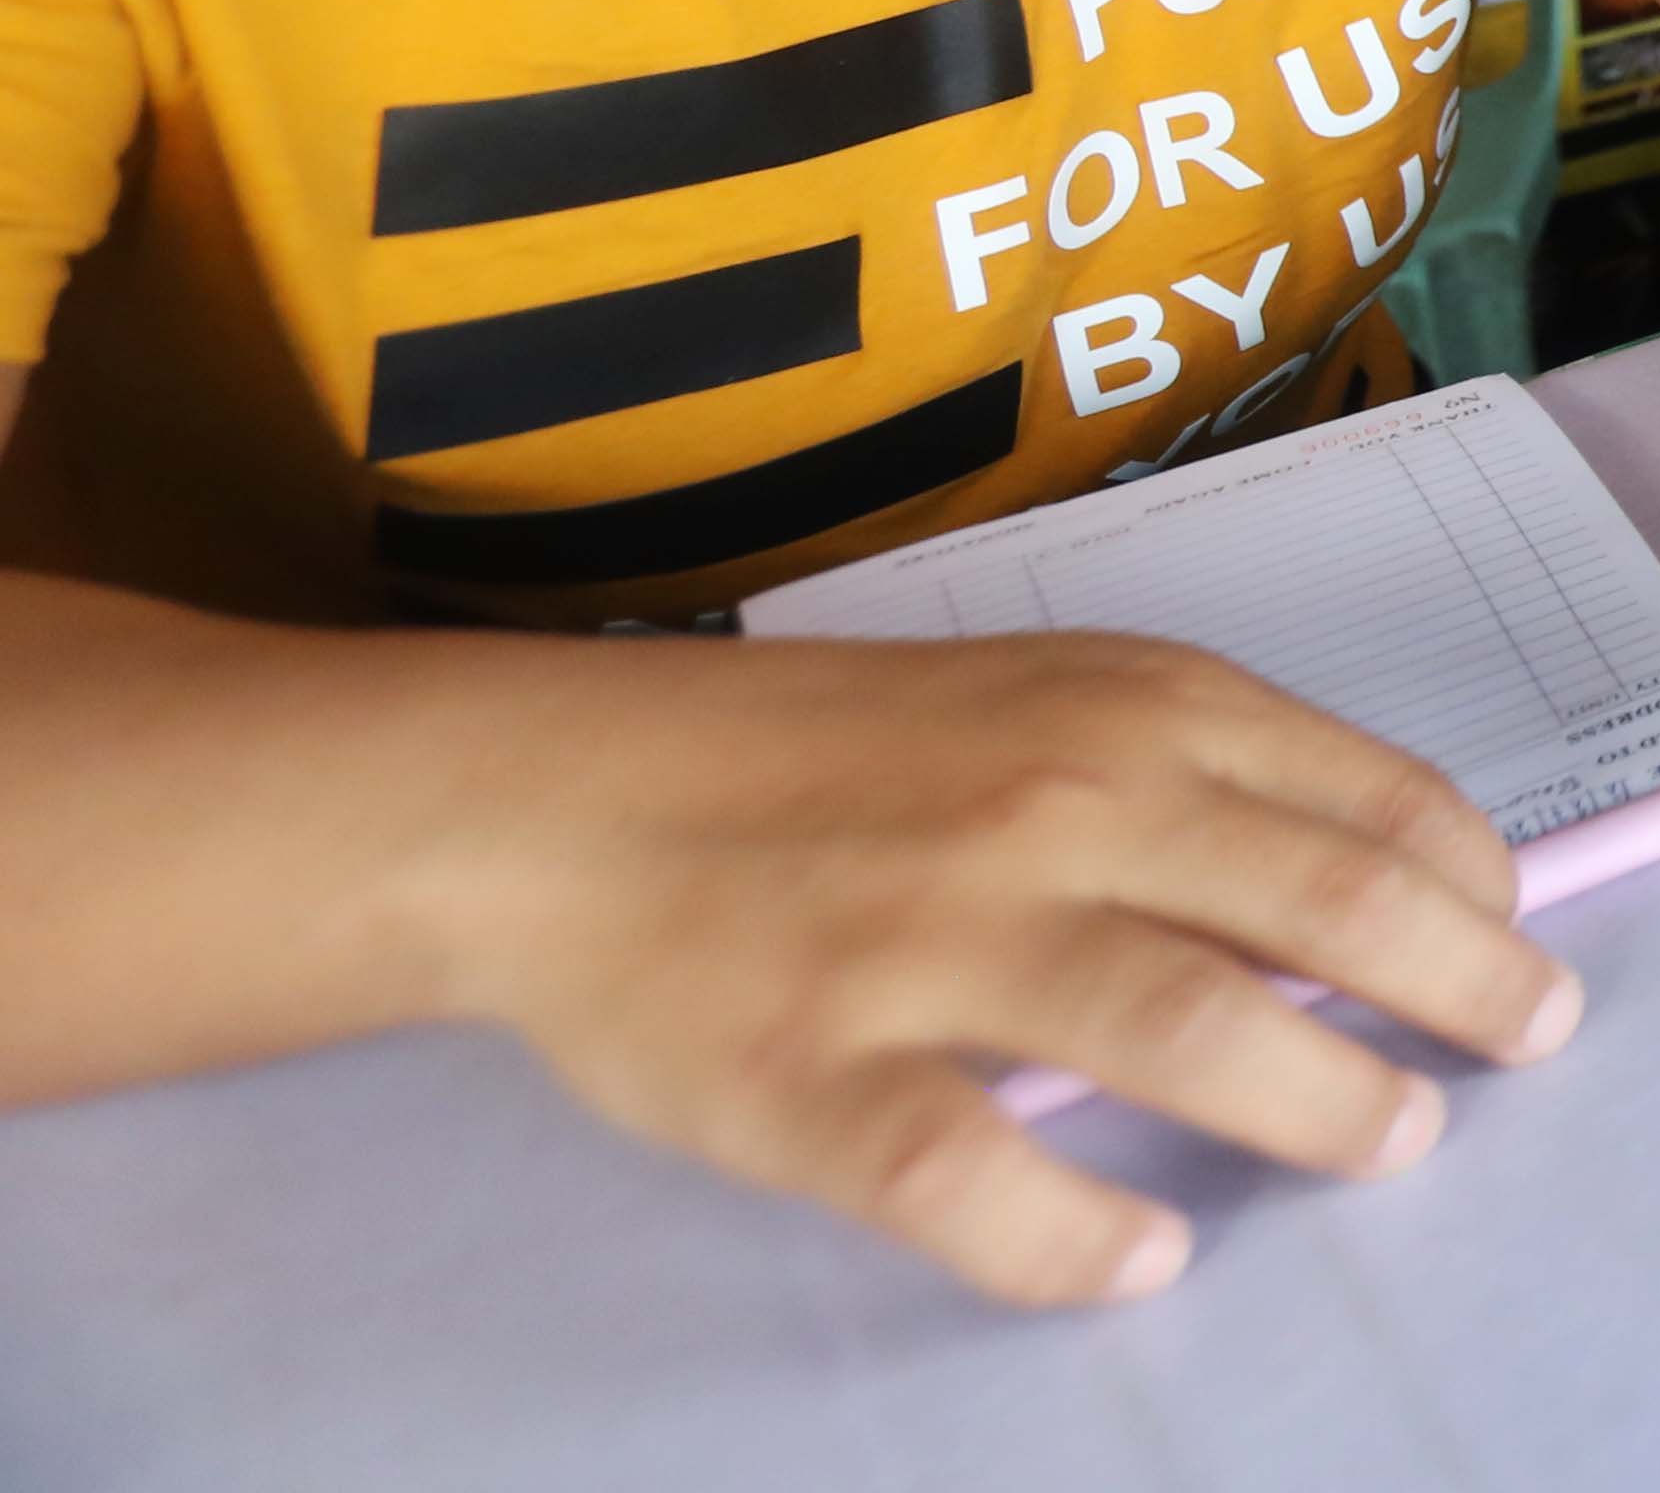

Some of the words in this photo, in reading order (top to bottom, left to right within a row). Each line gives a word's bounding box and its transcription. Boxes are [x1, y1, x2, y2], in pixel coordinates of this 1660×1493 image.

[933, 90, 1265, 312] FOR
[1051, 243, 1291, 418] BY
[1408, 403, 1499, 435] THANK
[1347, 432, 1401, 453] YOU
[1596, 744, 1633, 766] TO
